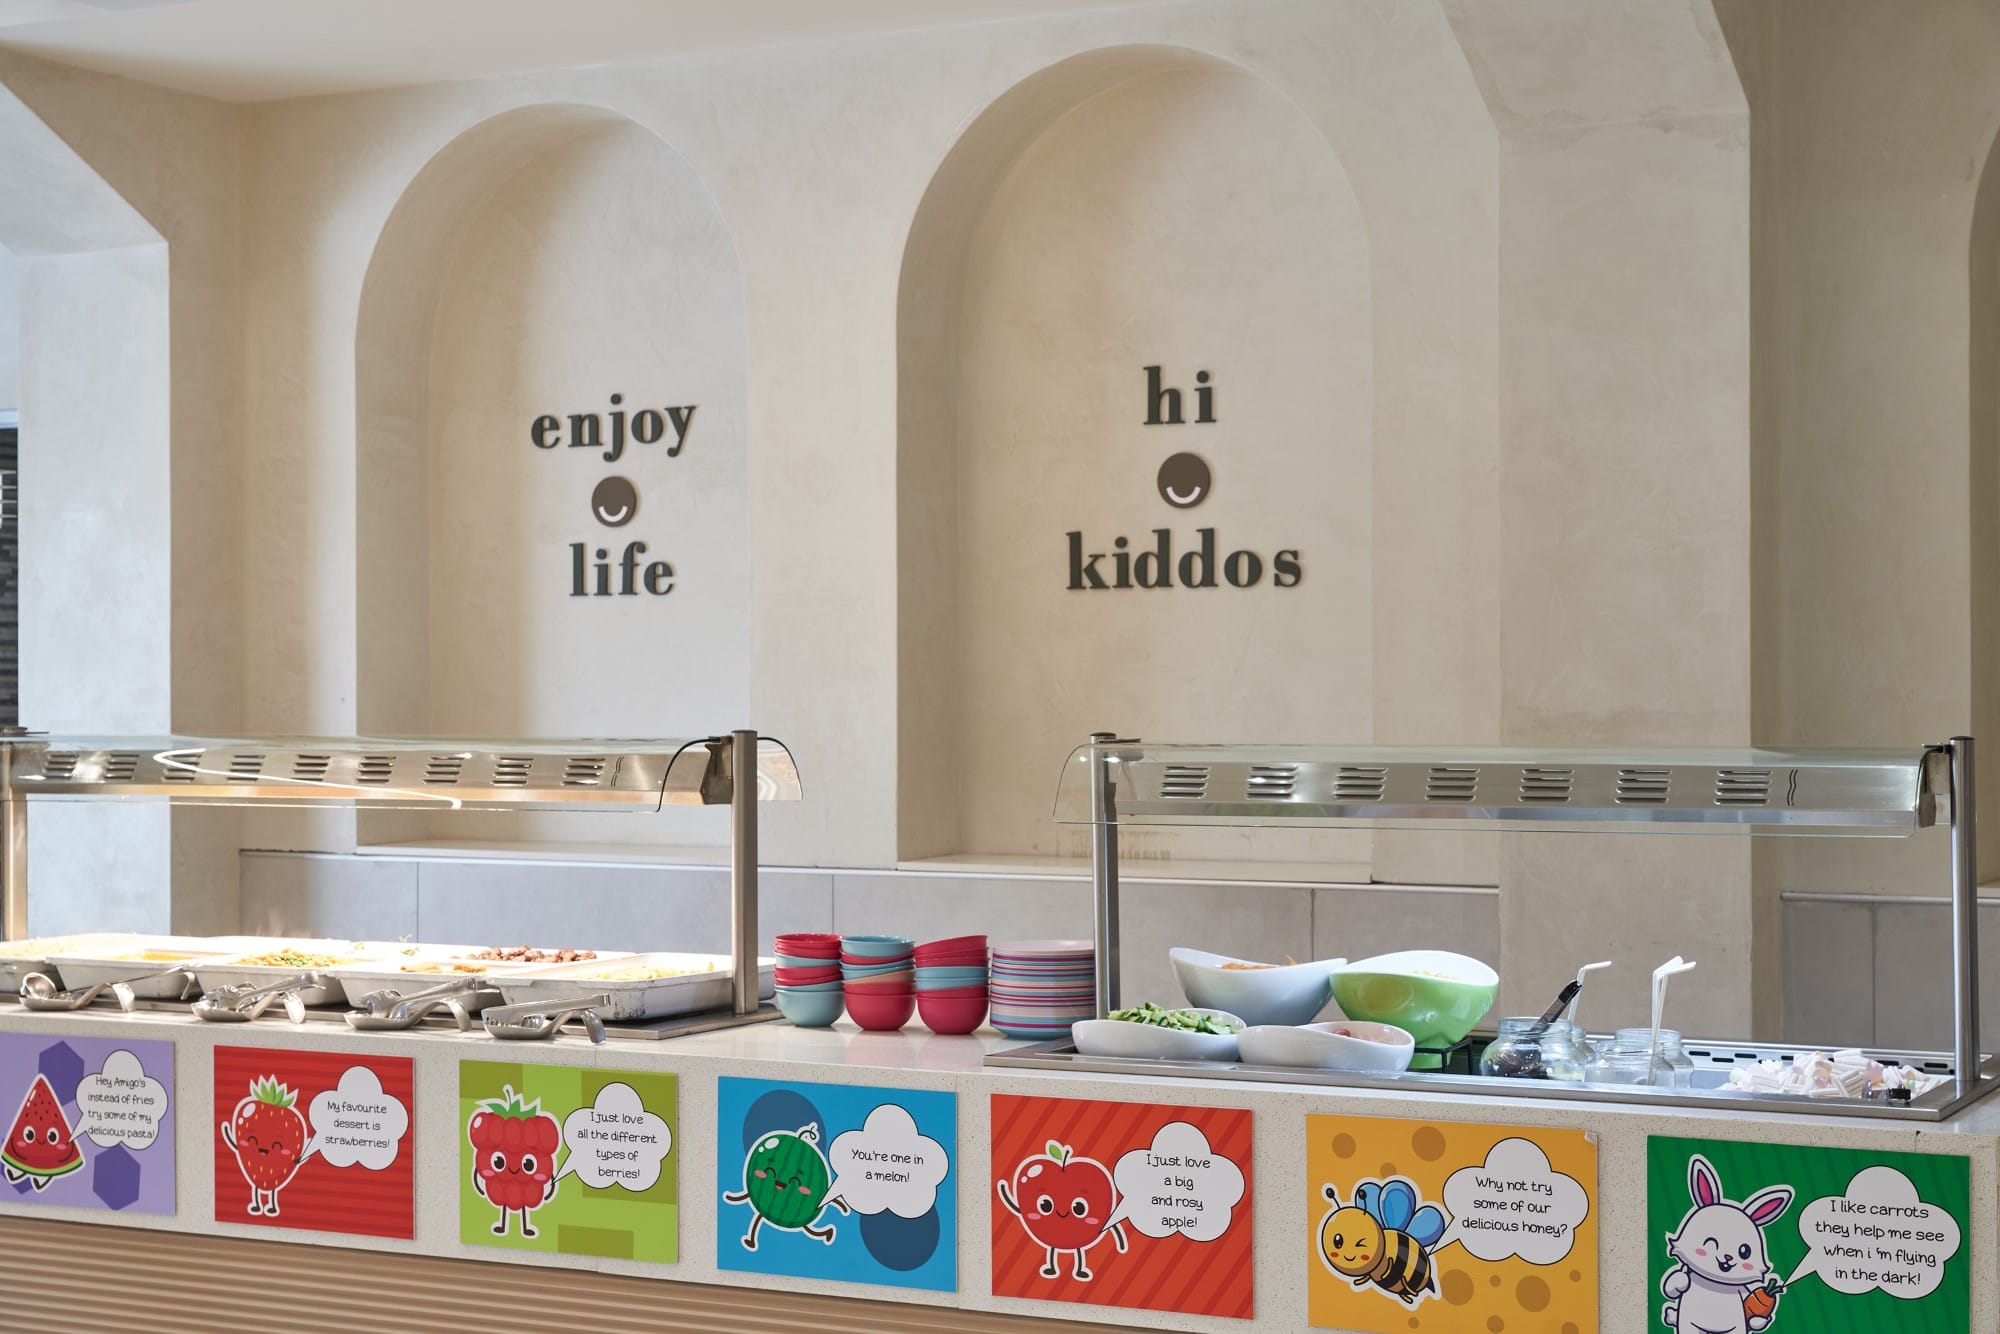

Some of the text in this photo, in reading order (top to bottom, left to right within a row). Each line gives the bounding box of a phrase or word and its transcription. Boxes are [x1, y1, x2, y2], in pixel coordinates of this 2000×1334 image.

[1143, 366, 1217, 425] hi
[531, 393, 697, 462] enjoy
[1066, 528, 1302, 590] kiddos
[569, 541, 674, 597] life
[96, 1076, 145, 1089] Hey Amigo's
[88, 1092, 154, 1105] instead of fries
[328, 1101, 387, 1114] My favourite
[88, 1110, 152, 1124] try some of my
[334, 1118, 380, 1130] dessert is
[622, 1113, 643, 1124] love
[88, 1126, 154, 1139] delicious pasta!
[578, 1129, 657, 1143] all the different
[325, 1136, 390, 1148] strawberries!
[596, 1149, 638, 1161] types of
[851, 1149, 923, 1164] You're one in
[1185, 1156, 1211, 1168] love
[598, 1166, 640, 1178] berries!
[865, 1171, 910, 1182] a melon!
[1164, 1176, 1193, 1190] a big
[1475, 1177, 1552, 1195] Why not try
[1152, 1195, 1203, 1211] and rosy
[1474, 1200, 1551, 1214] some of our
[1831, 1200, 1929, 1218] I like carrots
[1162, 1217, 1197, 1229] apple!
[1462, 1217, 1568, 1237] delicious honey?
[1815, 1221, 1945, 1242] they help me see
[1824, 1245, 1863, 1258] when
[1895, 1249, 1936, 1267] flying
[1835, 1267, 1921, 1285] in the dark!
